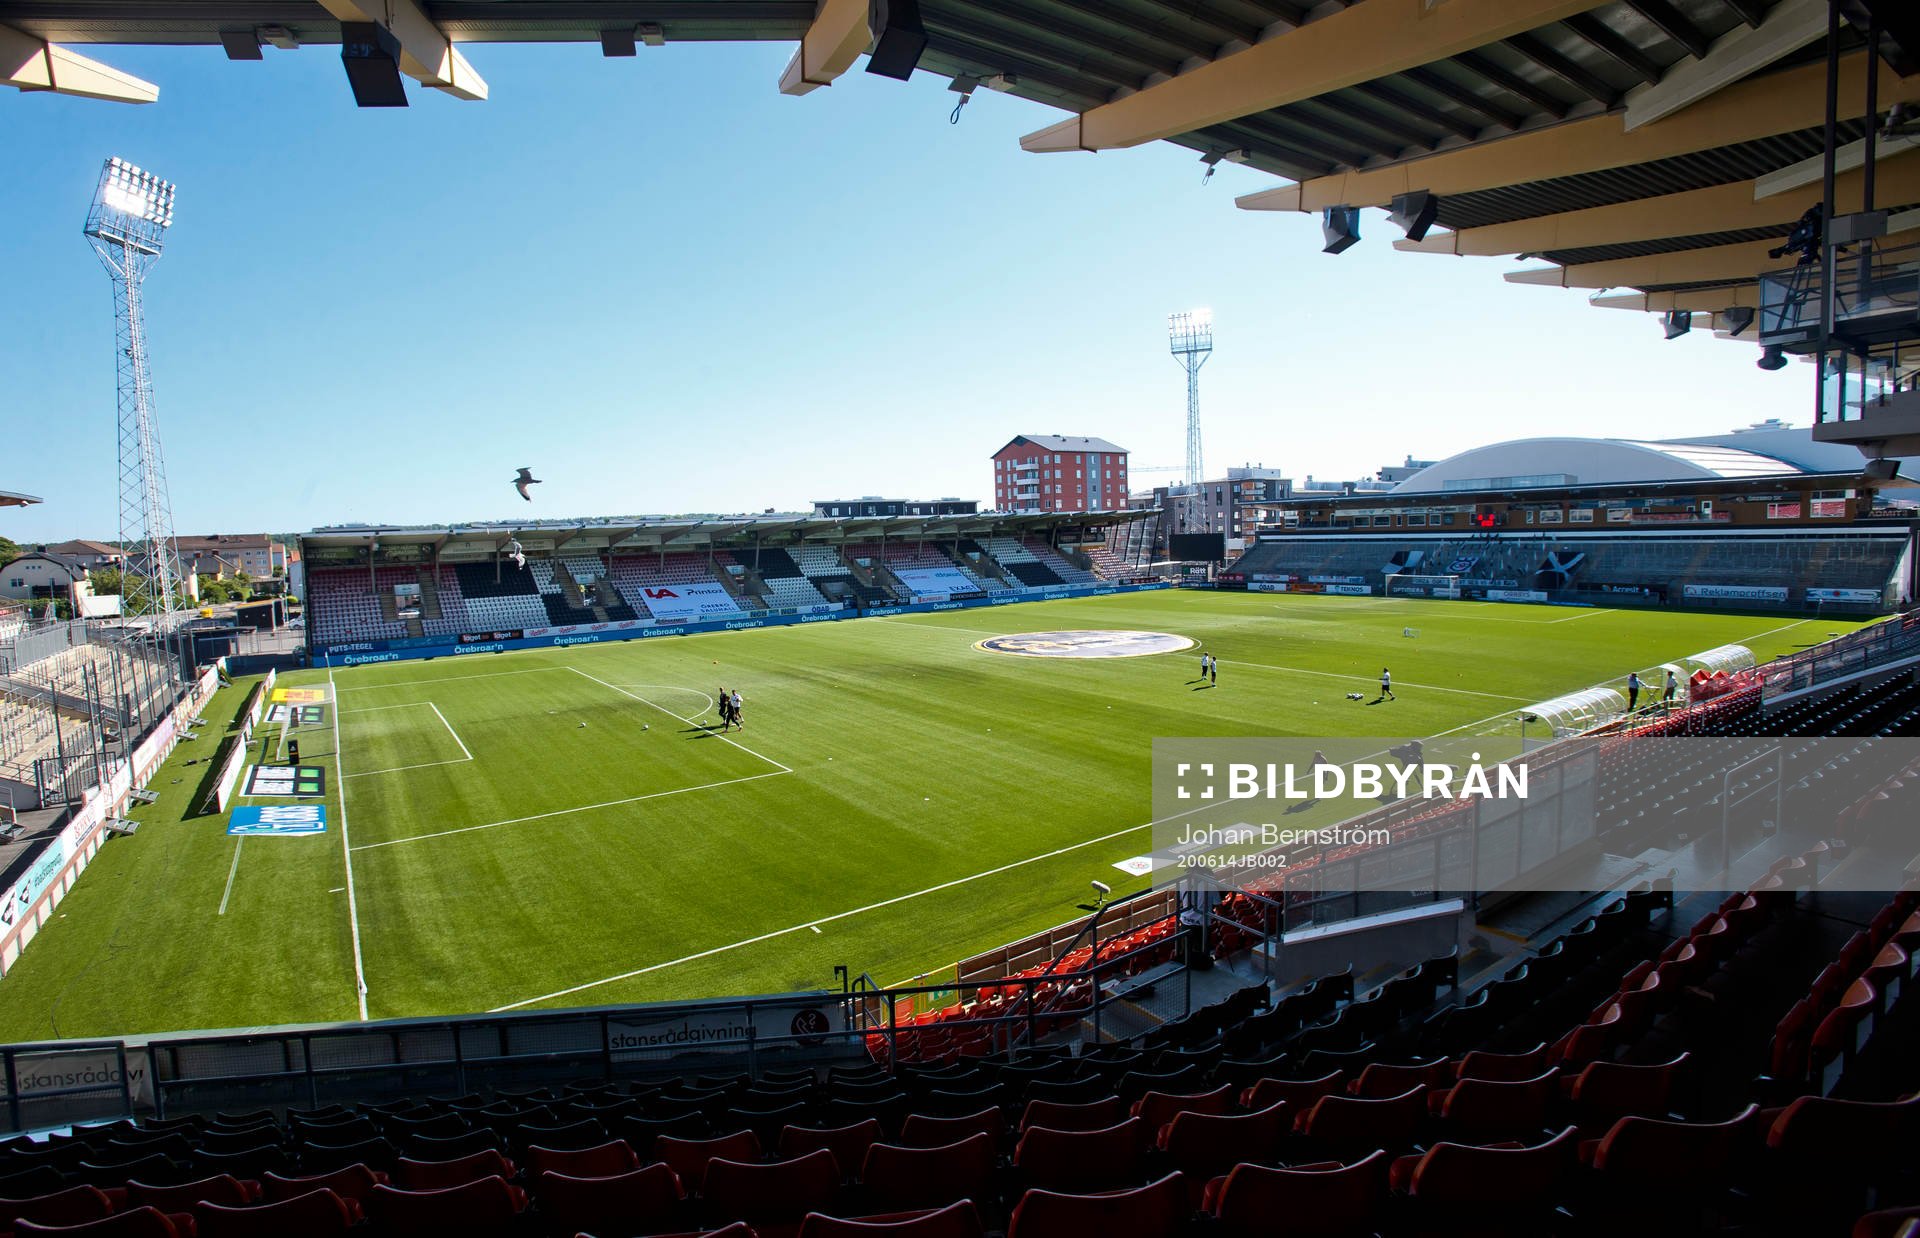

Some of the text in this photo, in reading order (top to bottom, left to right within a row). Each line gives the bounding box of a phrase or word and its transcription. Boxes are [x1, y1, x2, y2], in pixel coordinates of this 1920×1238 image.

[1340, 586, 1364, 594] TEKNOS
[801, 613, 837, 623] Örebroar'n
[725, 620, 764, 629] Örebroar'n
[642, 627, 685, 637] Örebroar'n
[553, 635, 599, 646] Örebroar'n
[454, 643, 504, 655] Örebroar'n
[343, 652, 399, 665] Örebroar'n
